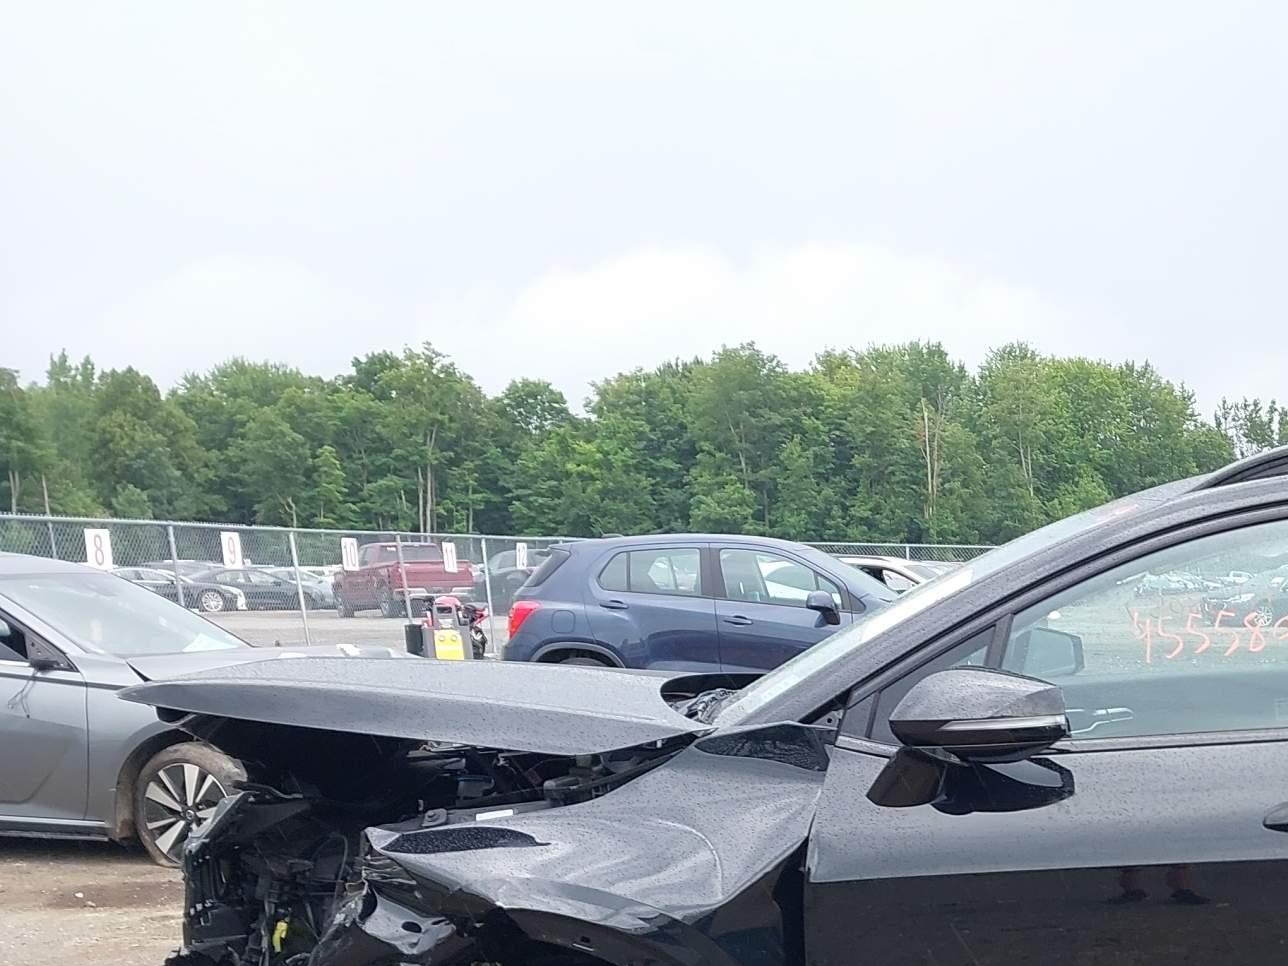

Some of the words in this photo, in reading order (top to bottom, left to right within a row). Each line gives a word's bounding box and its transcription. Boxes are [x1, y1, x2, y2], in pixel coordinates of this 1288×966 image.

[94, 534, 105, 566] 8
[227, 536, 237, 565] 9
[343, 540, 358, 568] 10
[444, 546, 457, 569] 11
